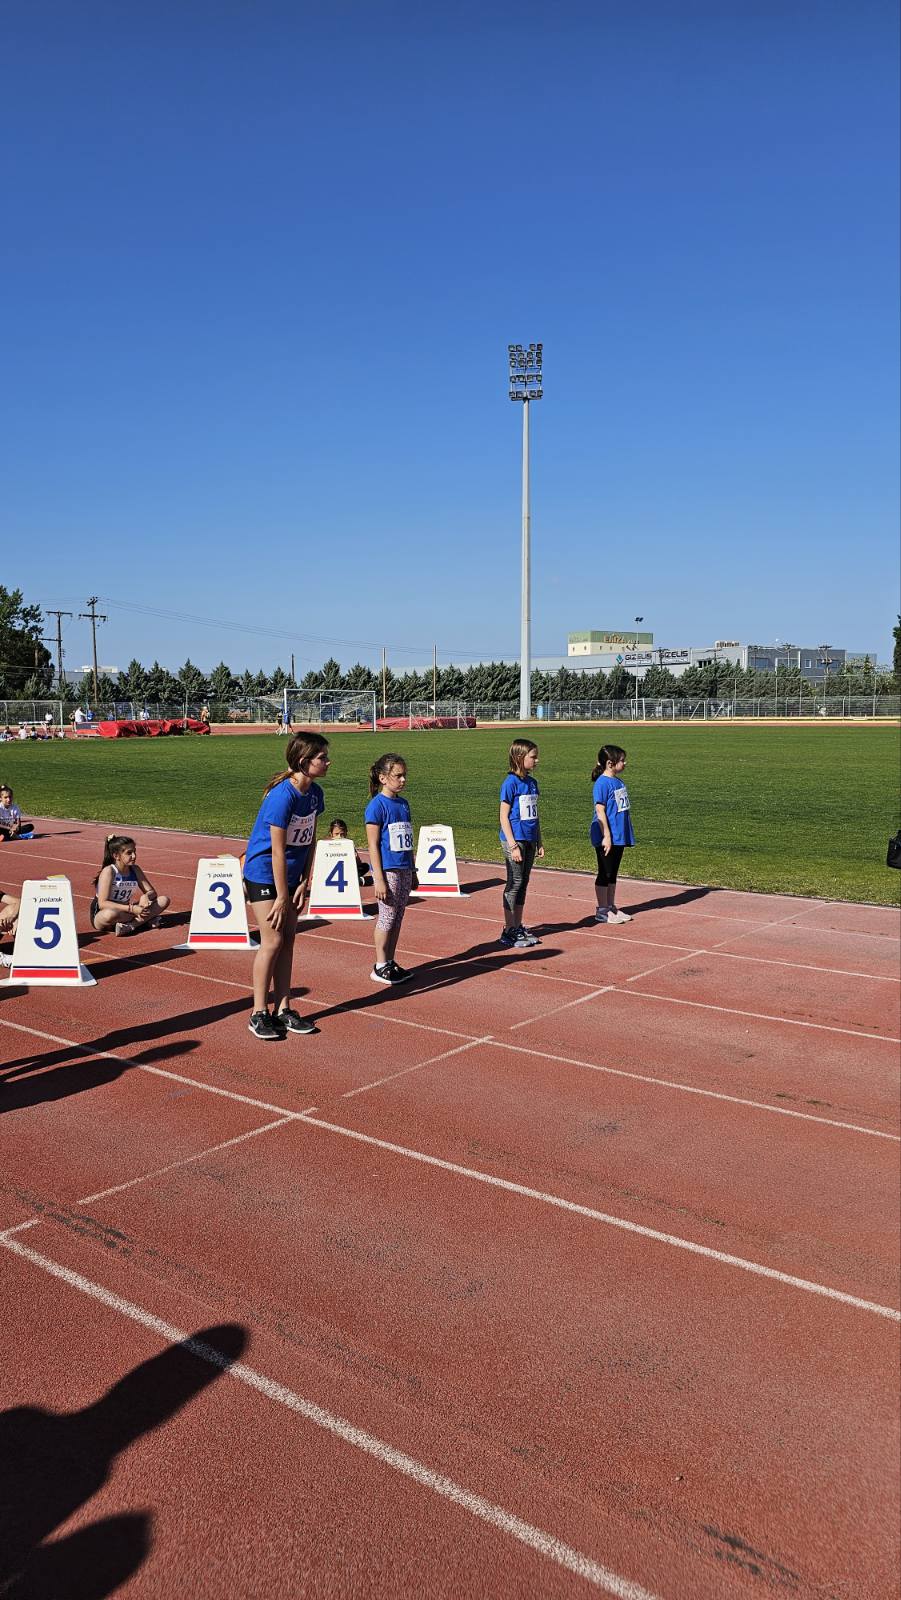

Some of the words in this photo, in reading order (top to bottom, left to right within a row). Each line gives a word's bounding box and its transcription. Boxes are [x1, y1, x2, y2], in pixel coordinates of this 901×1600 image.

[324, 860, 348, 893] 4
[427, 844, 447, 874] 2
[208, 881, 233, 919] 3
[33, 907, 62, 950] 5
